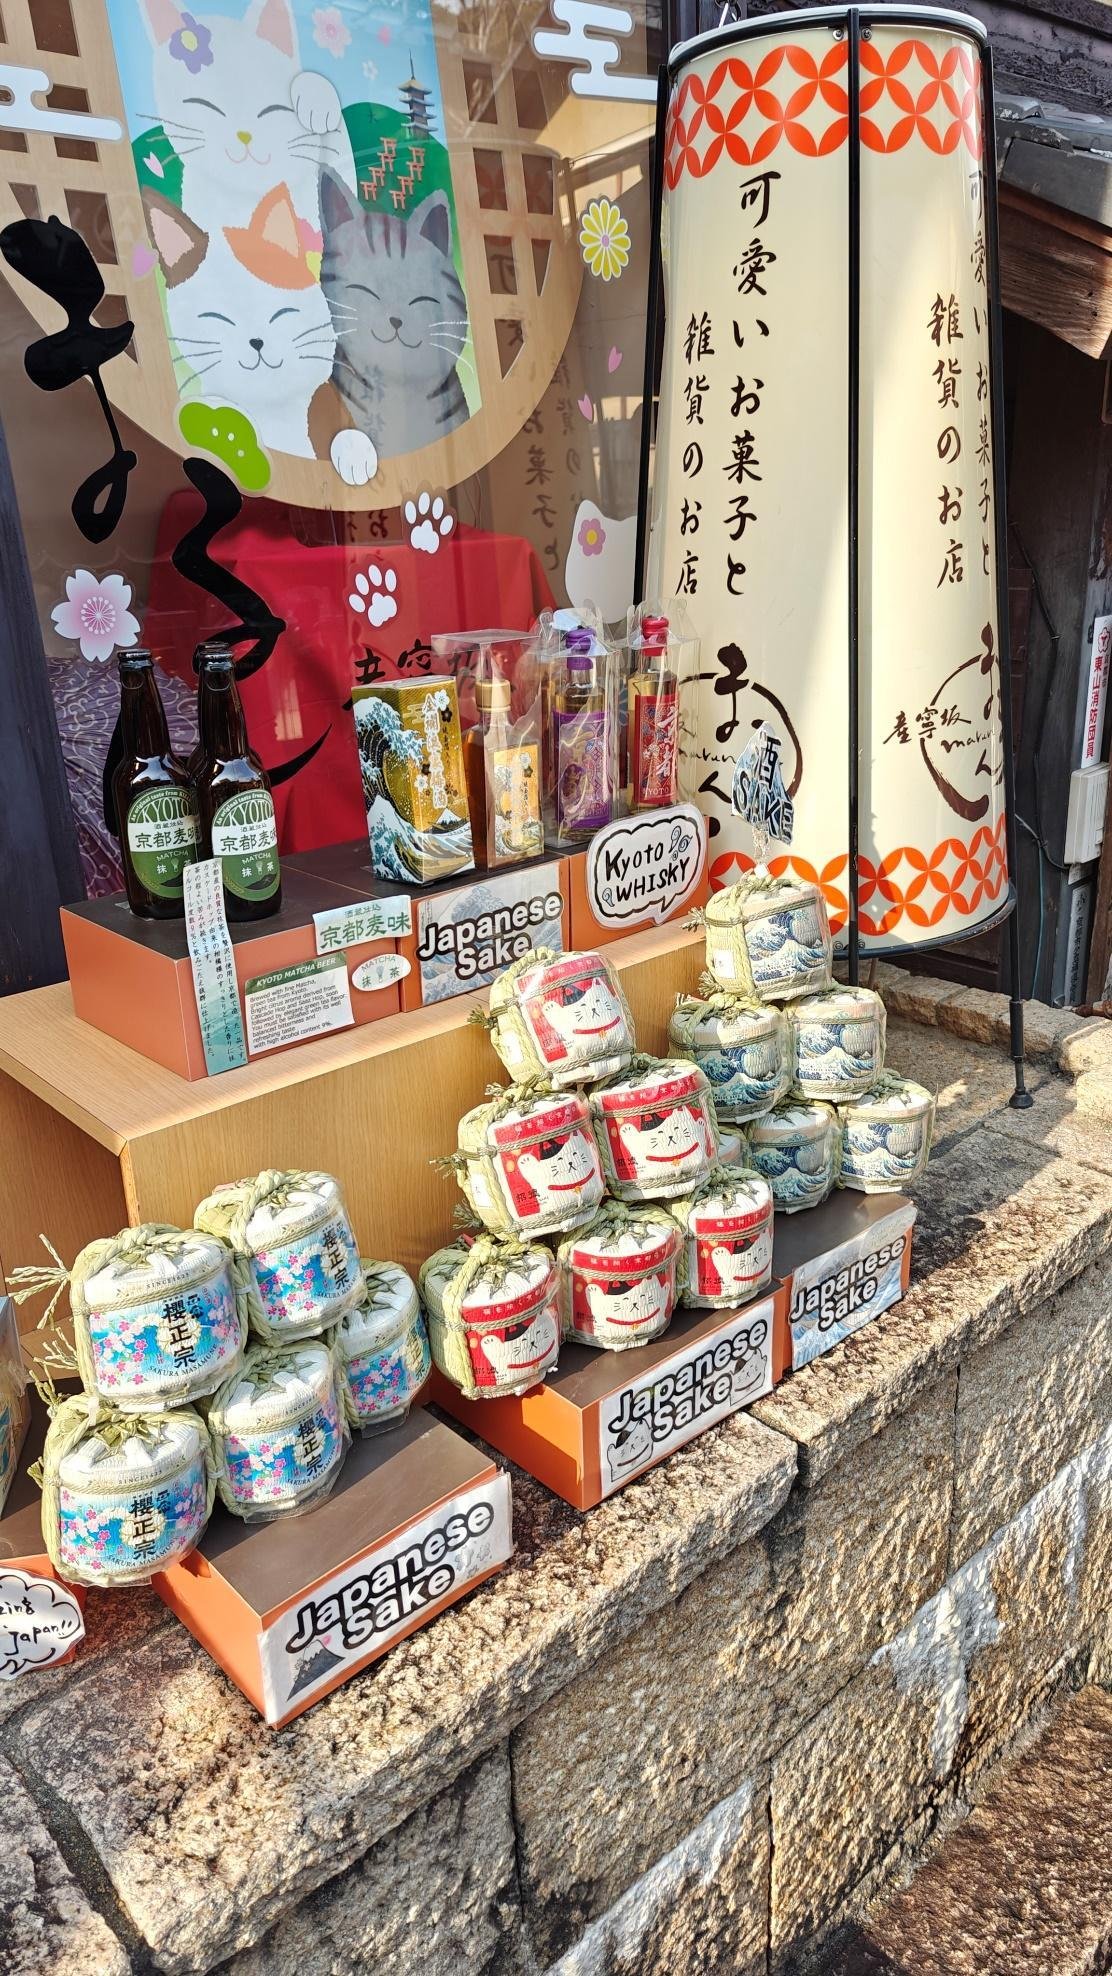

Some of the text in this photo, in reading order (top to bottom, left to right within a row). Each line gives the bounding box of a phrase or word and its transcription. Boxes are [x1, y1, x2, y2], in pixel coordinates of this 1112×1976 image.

[722, 171, 781, 595] 可愛いお菓子と
[675, 311, 715, 596] 雑貨のお店
[927, 293, 964, 588] 雑貨のお店
[883, 705, 971, 745] 産寧坂
[142, 797, 189, 823] KYOTO
[229, 799, 272, 826] KYOTO
[733, 771, 794, 844] SAKE
[156, 850, 188, 862] MATCHA
[242, 853, 271, 865] MATCHA
[605, 841, 664, 881] Kyoto
[616, 856, 690, 902] WHISKY
[320, 911, 411, 949] 京都麦味
[417, 892, 562, 961] Japanese
[256, 958, 336, 987] KYOTO MATCHA BEER
[361, 955, 396, 972] MATCHA
[389, 966, 400, 978] 茶
[456, 932, 532, 979] Sake
[250, 993, 270, 1002] Brewed
[251, 1014, 274, 1025] followed
[283, 1008, 303, 1018] elegant
[305, 1002, 319, 1012] green
[251, 1010, 273, 1020] Cascade
[268, 1001, 283, 1009] citrus
[303, 990, 322, 998] derived
[252, 1023, 263, 1031] You
[264, 1019, 278, 1027] must
[288, 1010, 310, 1021] satisfied
[252, 1014, 316, 1037] balanced bitterness and
[253, 1032, 280, 1043] refreshing
[267, 1037, 279, 1047] high
[281, 1031, 300, 1040] alcohol
[301, 1025, 320, 1034] content
[790, 1235, 906, 1323] Japanese
[818, 1276, 878, 1332] Sake
[162, 1299, 198, 1369] 櫻正宗
[148, 1343, 219, 1377] SAKURA MASAMUNE
[608, 1319, 767, 1433] Japanese
[651, 1373, 733, 1442] Sake
[298, 1416, 324, 1477] 櫻正宗
[130, 1495, 157, 1560] 櫻正宗
[286, 1502, 494, 1654] Japanese
[343, 1563, 456, 1649] Sake
